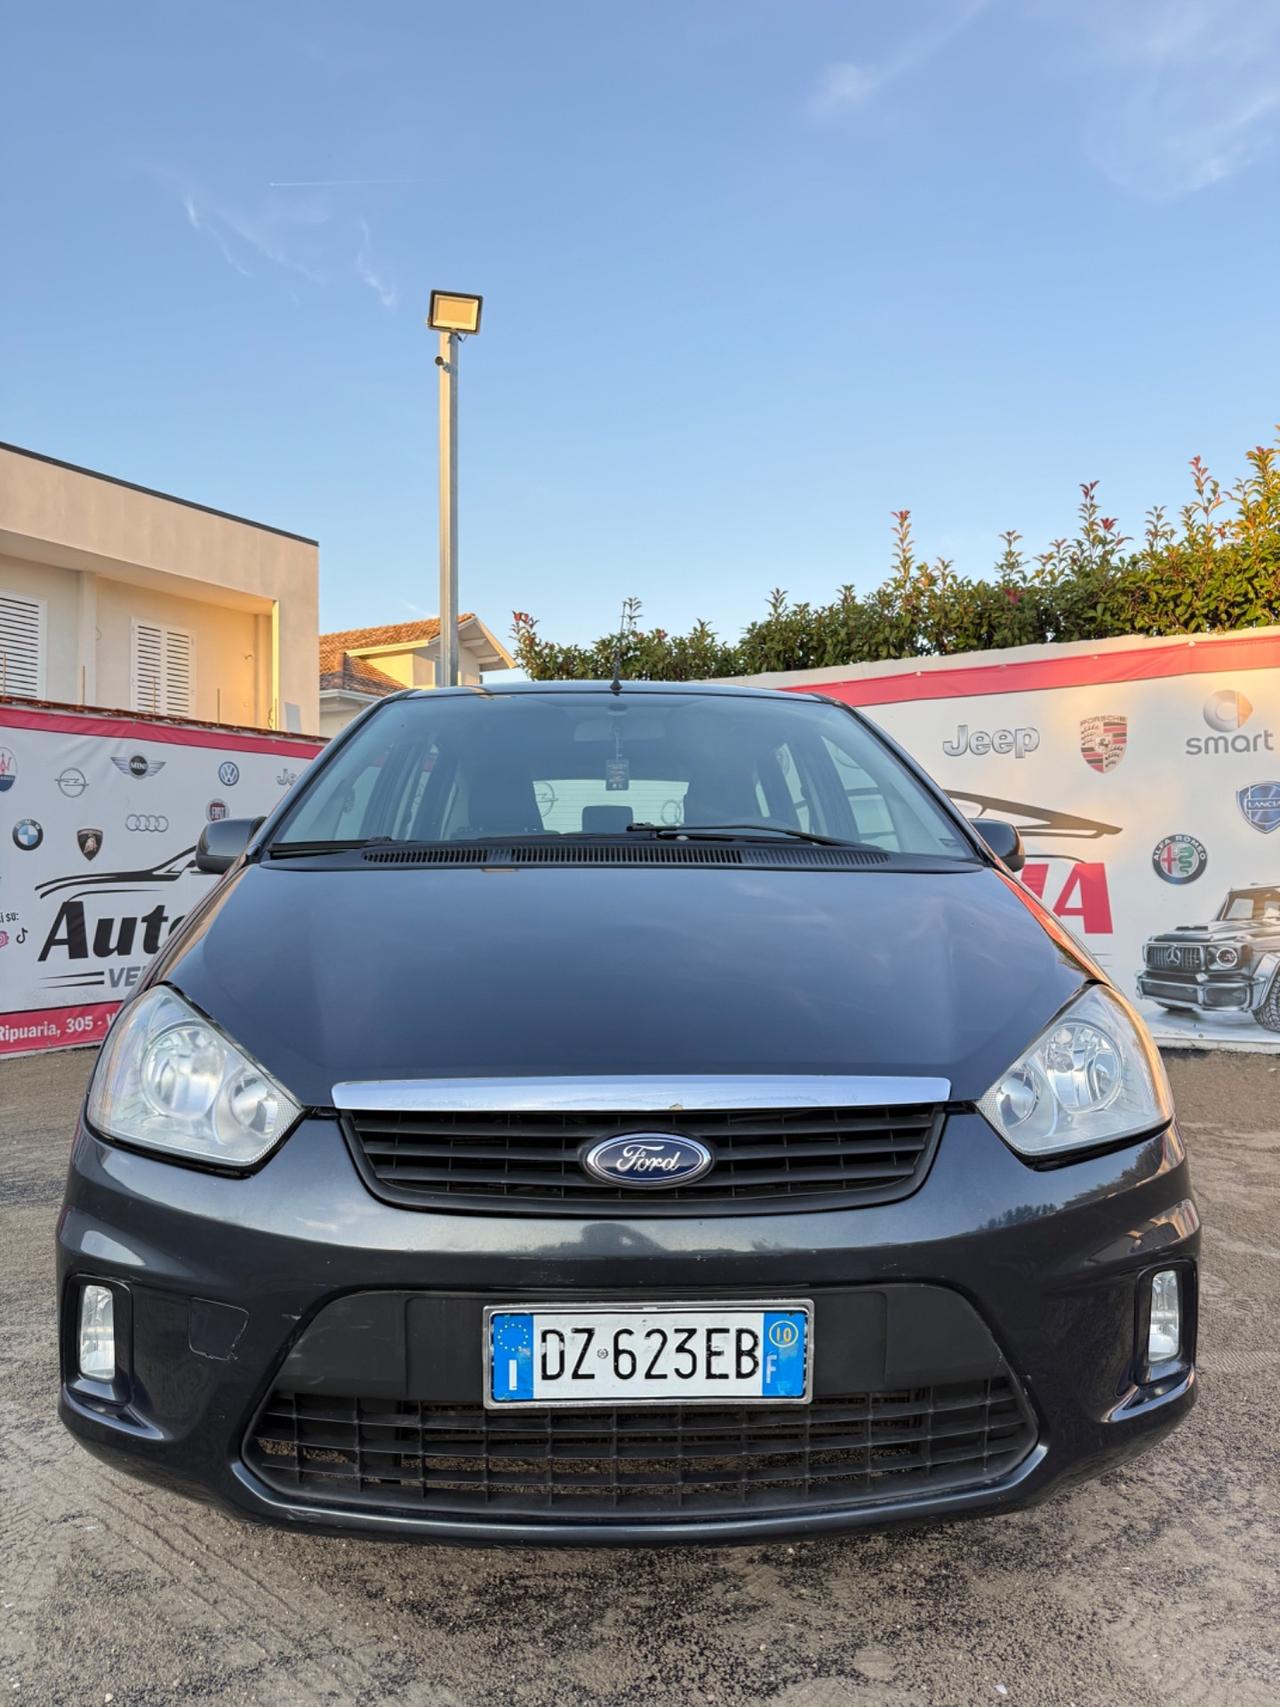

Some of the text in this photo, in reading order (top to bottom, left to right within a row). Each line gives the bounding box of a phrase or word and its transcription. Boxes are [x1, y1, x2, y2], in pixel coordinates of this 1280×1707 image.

[943, 724, 1041, 759] Jeep
[1185, 730, 1274, 755] smart
[65, 1015, 94, 1033] 305
[616, 1144, 682, 1172] Ford
